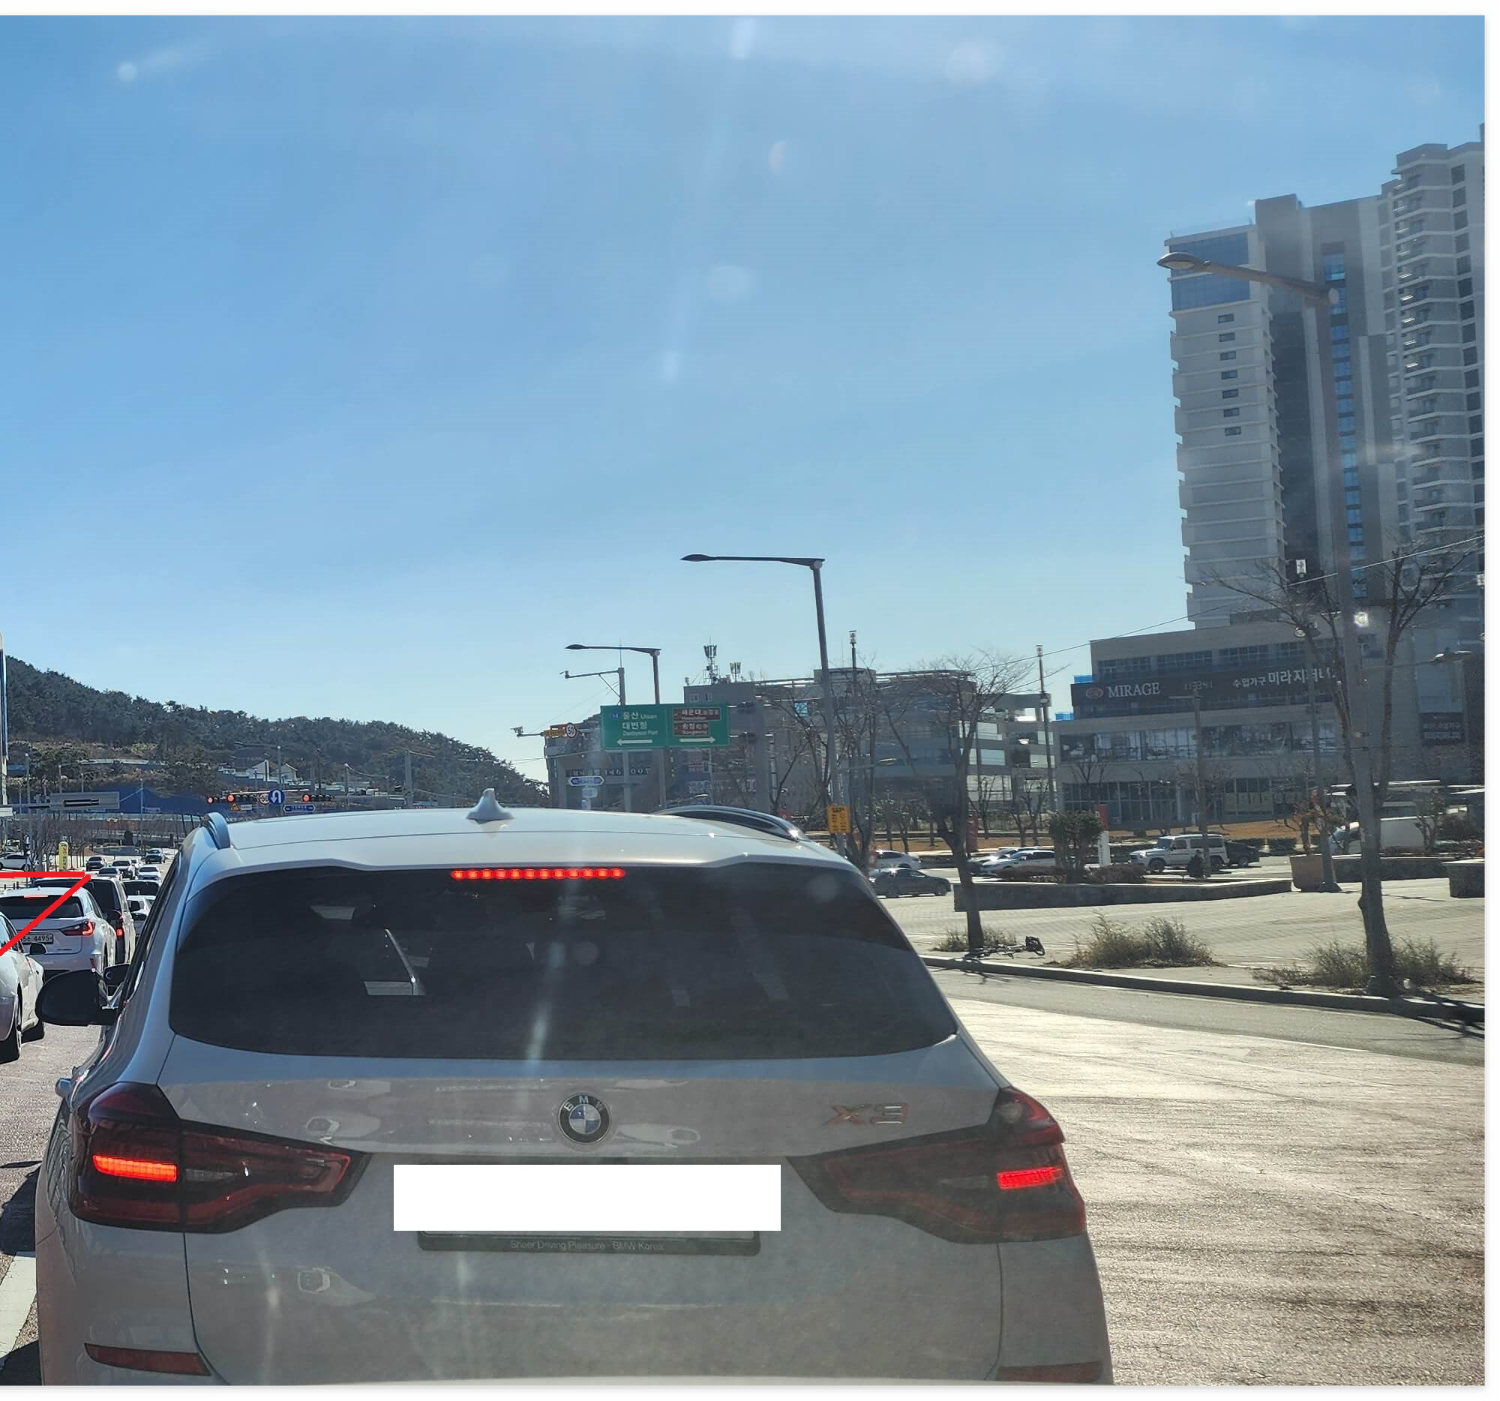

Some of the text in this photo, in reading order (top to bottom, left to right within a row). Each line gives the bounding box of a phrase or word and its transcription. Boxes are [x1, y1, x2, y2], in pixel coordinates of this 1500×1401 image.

[1233, 676, 1267, 688] 수입가구
[1107, 682, 1161, 698] MIRAGE
[623, 711, 639, 720] 울산
[822, 1103, 909, 1128] X3
[509, 1240, 535, 1250] Sheer
[537, 1240, 566, 1251] Driving
[568, 1240, 606, 1250] Pleasure
[612, 1241, 636, 1250] BMW
